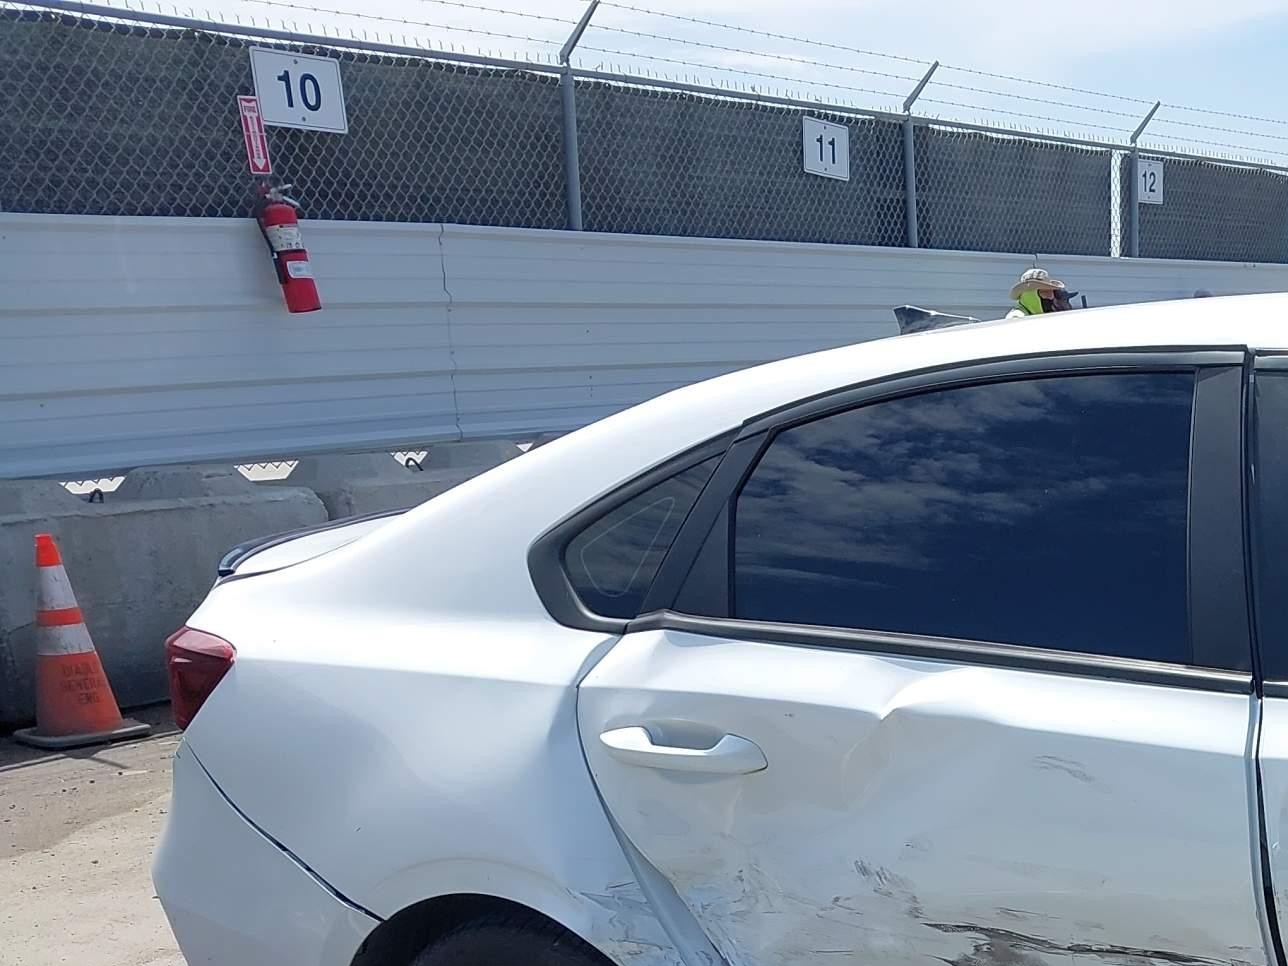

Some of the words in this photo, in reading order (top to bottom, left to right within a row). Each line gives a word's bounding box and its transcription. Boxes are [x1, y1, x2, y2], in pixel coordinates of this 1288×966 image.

[277, 69, 322, 112] 10
[816, 134, 836, 165] 11
[1142, 169, 1156, 193] 12
